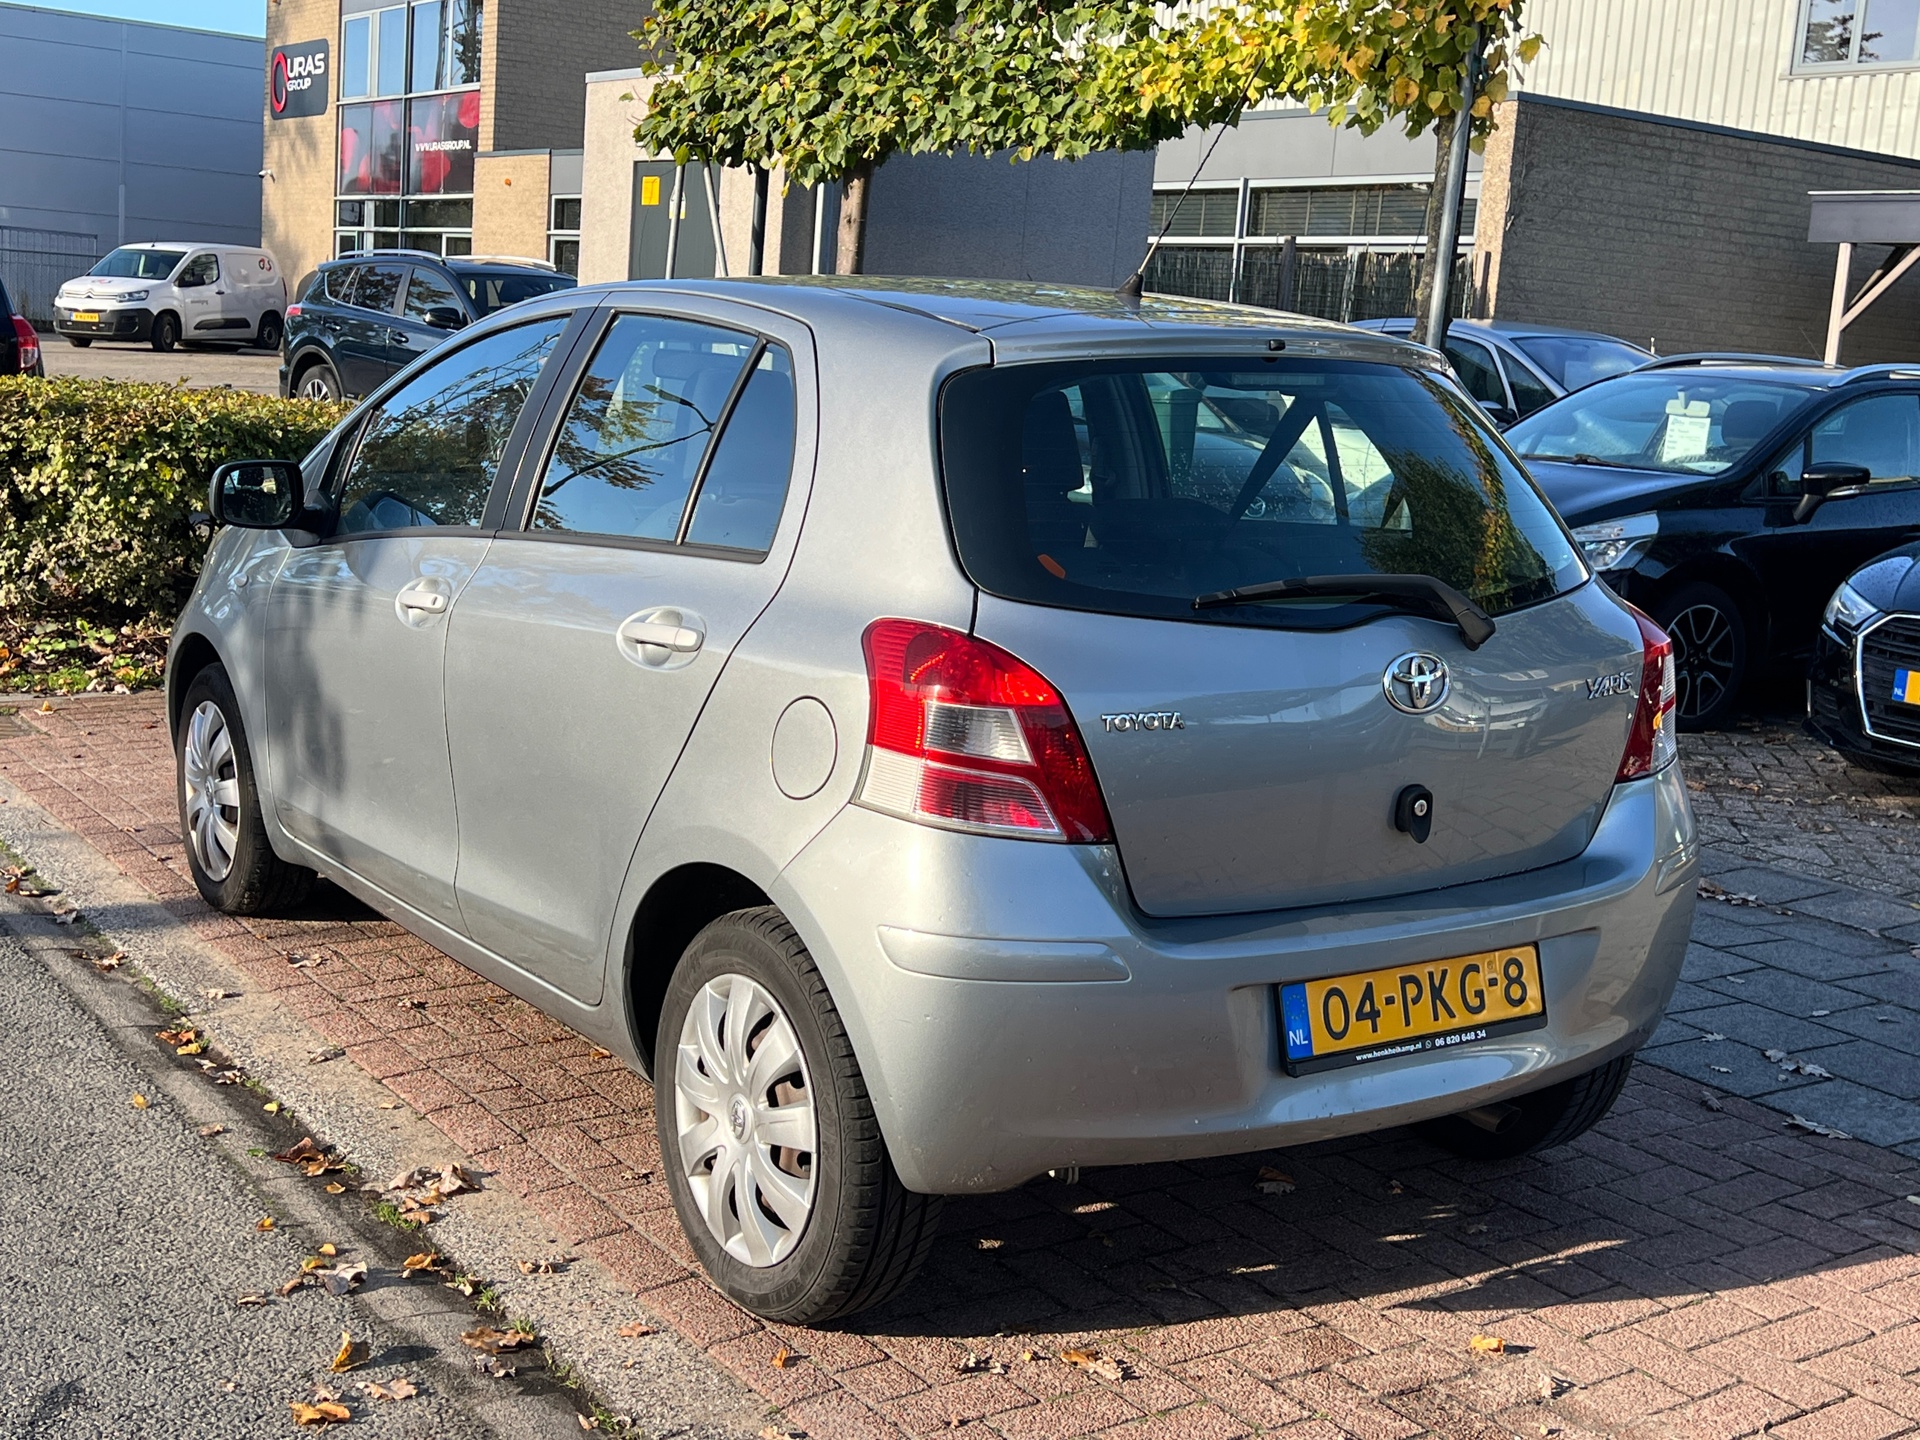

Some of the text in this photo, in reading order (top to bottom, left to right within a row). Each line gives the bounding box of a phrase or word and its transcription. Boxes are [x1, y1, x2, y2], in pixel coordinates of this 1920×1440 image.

[287, 53, 325, 78] URAS
[287, 77, 312, 91] GROUP
[1893, 687, 1905, 697] NL
[1101, 711, 1185, 733] TOYOTA
[1322, 956, 1528, 1041] 04-PKG-8
[1288, 1028, 1309, 1047] NL
[1435, 1037, 1445, 1047] 06
[1446, 1034, 1461, 1046] 820
[1476, 1029, 1486, 1039] 34
